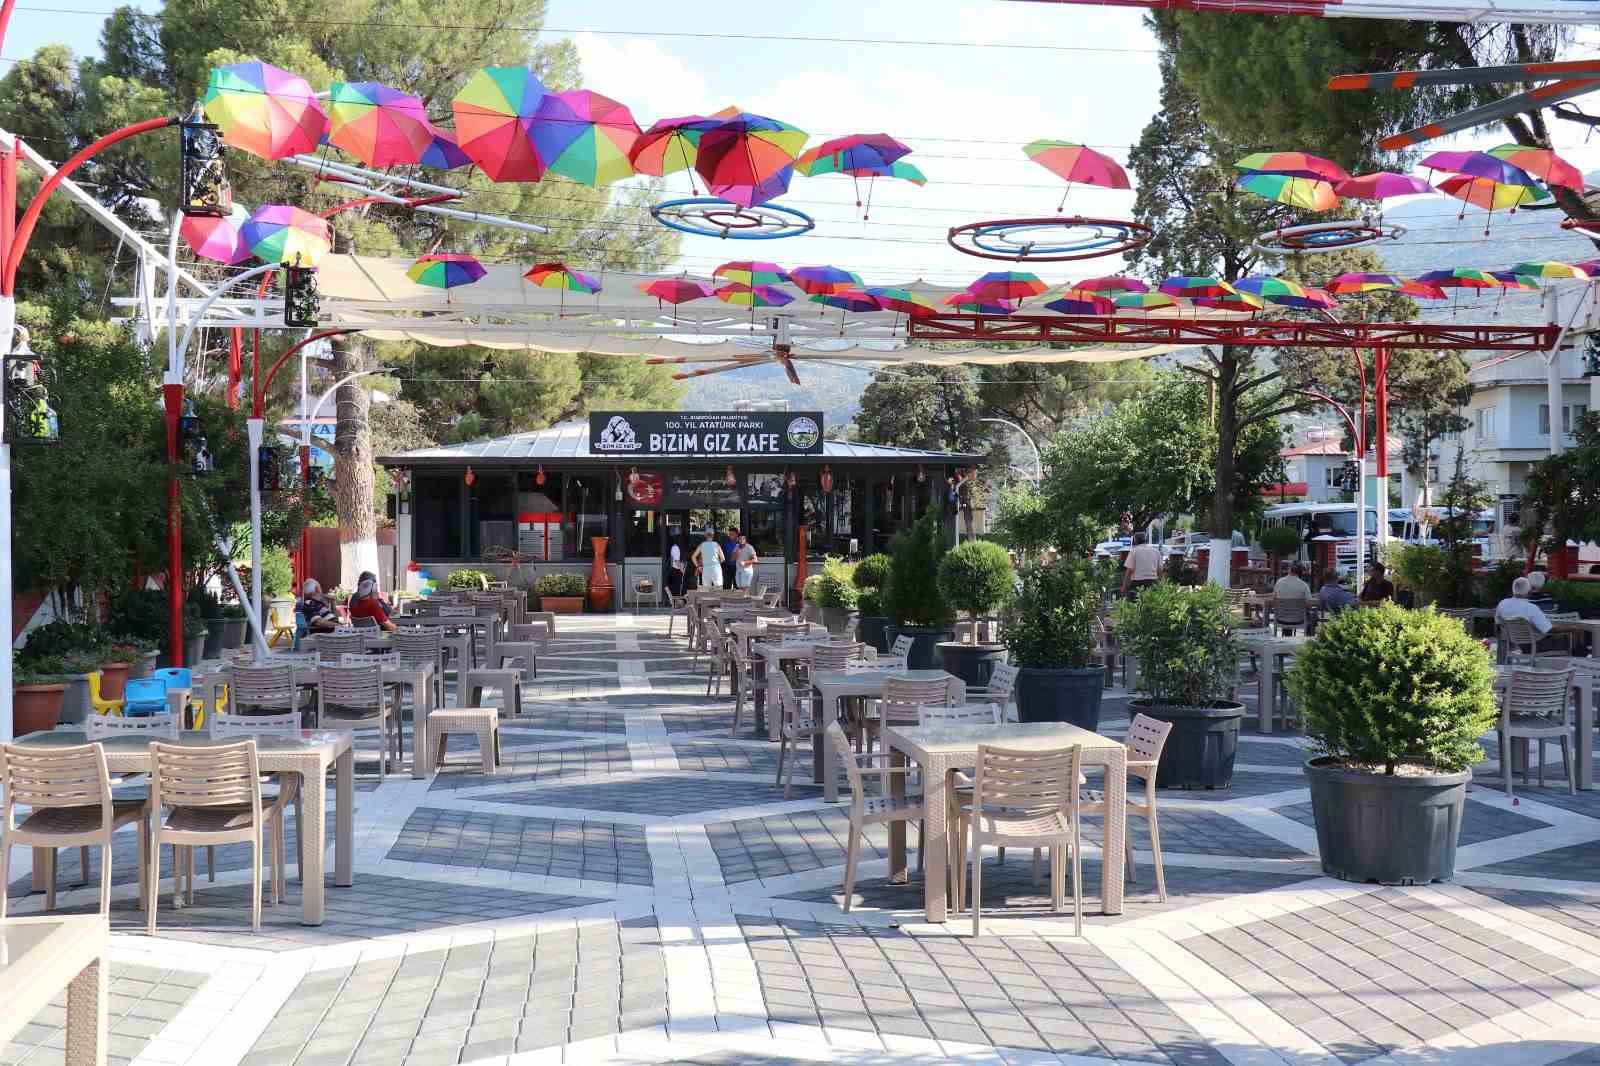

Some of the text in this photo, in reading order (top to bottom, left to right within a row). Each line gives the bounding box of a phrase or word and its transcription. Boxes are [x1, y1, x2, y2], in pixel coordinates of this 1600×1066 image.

[665, 419, 764, 429] 100. YIL ATATÜRK PARKI
[649, 433, 780, 452] BİZİM GIZ KAFE
